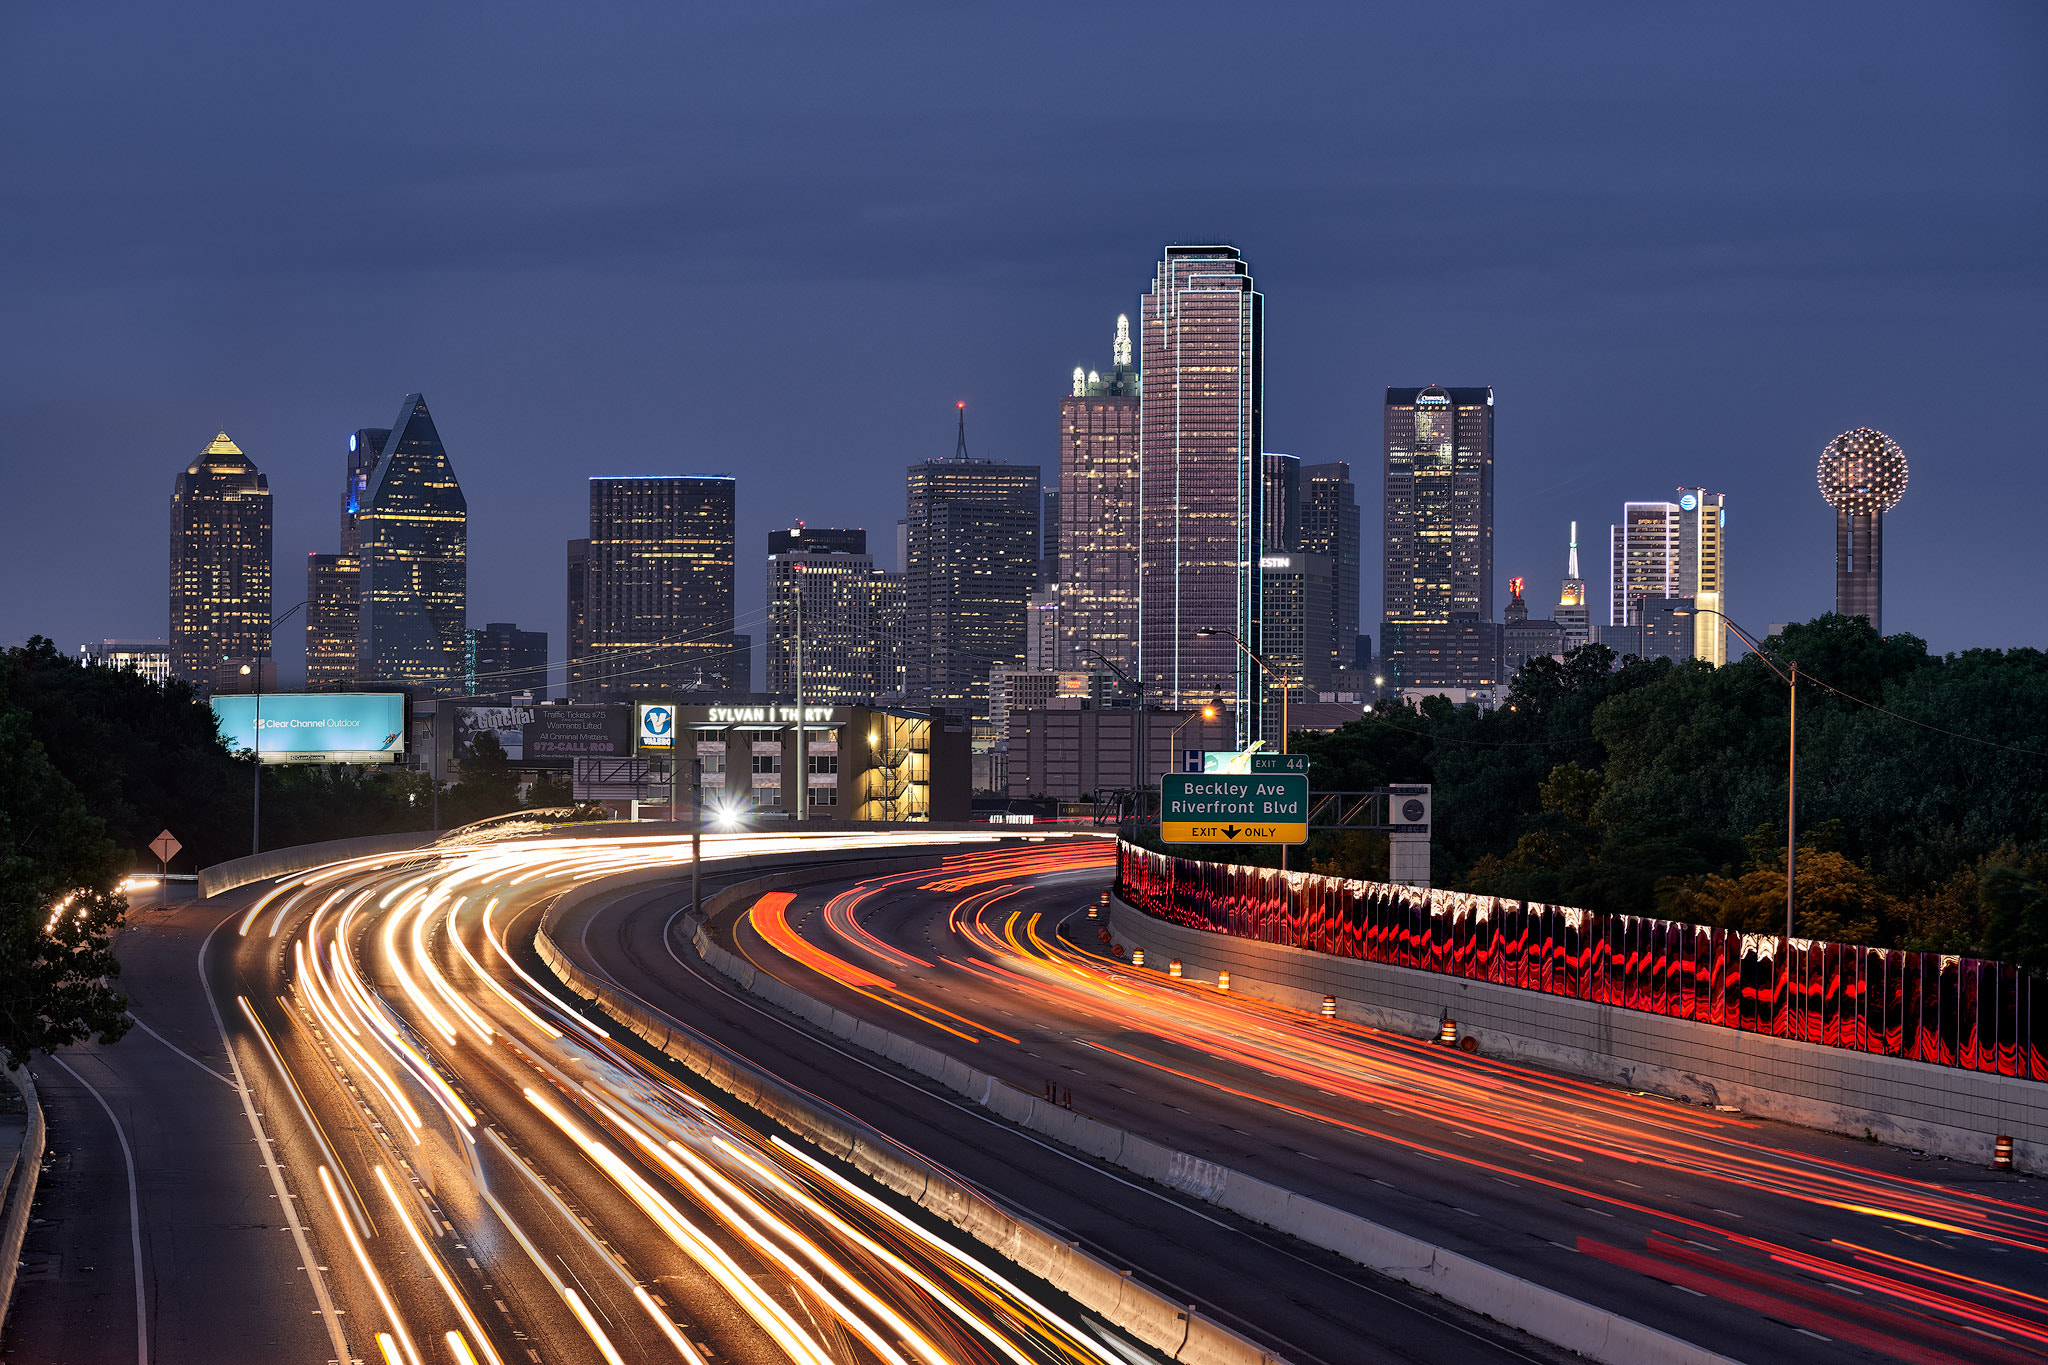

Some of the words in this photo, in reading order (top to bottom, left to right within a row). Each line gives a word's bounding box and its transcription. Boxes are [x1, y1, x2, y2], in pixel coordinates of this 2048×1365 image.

[1260, 557, 1290, 568] ESTIN
[477, 708, 535, 729] Gotcha!
[543, 711, 565, 719] Traffic
[566, 711, 591, 719] Tickets
[591, 711, 607, 719] $75
[709, 708, 764, 722] SYLVAN
[779, 708, 833, 722] THRTY
[266, 719, 289, 728] Clear
[290, 719, 325, 728] Channel
[326, 718, 361, 728] Outdoor
[546, 721, 582, 730] Warrants
[583, 721, 602, 730] Lifted
[580, 733, 608, 741] Matters
[1185, 750, 1203, 772] H
[1255, 760, 1277, 768] EXIT
[1286, 758, 1304, 770] 44
[1184, 782, 1248, 799] Beckley
[1256, 783, 1285, 796] Ave
[1171, 800, 1255, 814] Riverfront
[1263, 801, 1298, 814] Blvd
[1192, 827, 1217, 837] EXIT
[1245, 827, 1277, 837] ONLY
